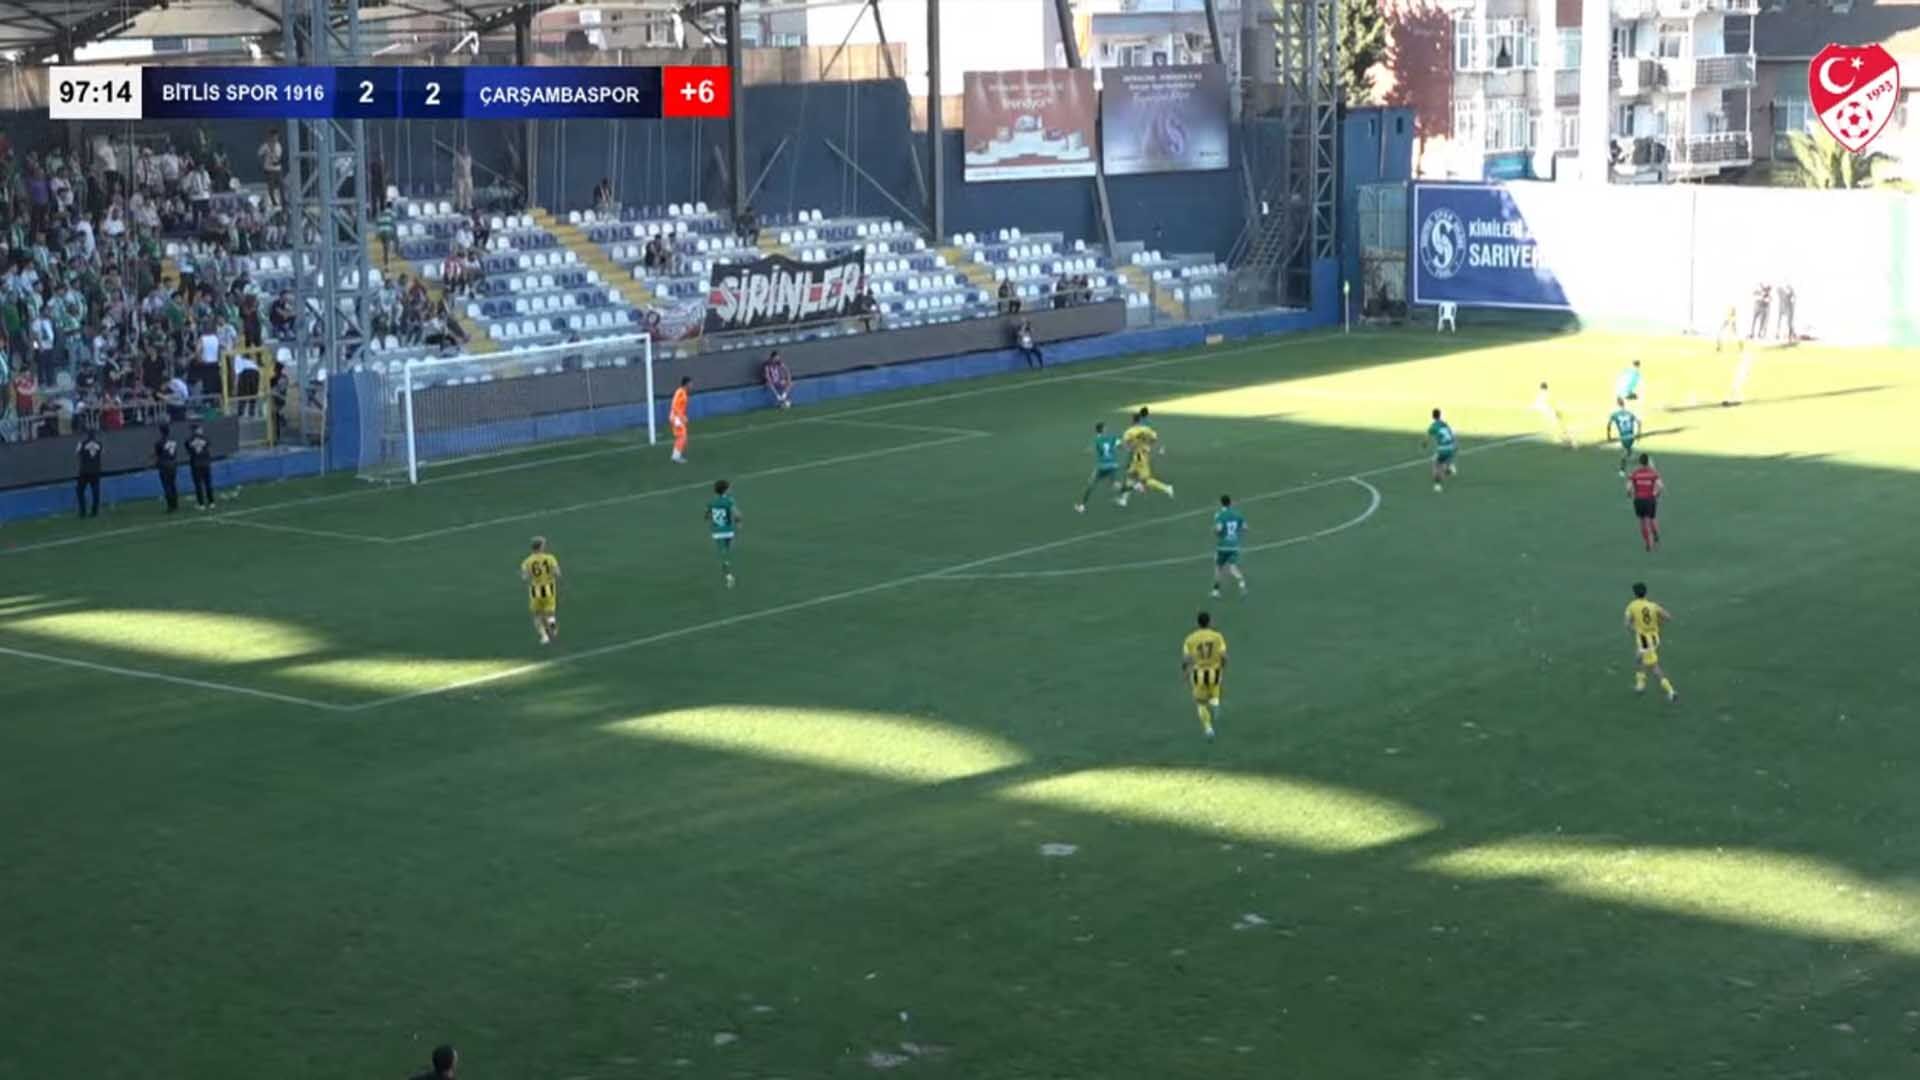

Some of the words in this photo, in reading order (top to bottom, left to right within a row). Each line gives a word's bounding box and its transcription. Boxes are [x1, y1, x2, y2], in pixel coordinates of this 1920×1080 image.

[531, 559, 550, 578] 61
[1641, 606, 1652, 625] 8
[1196, 641, 1214, 660] 17
